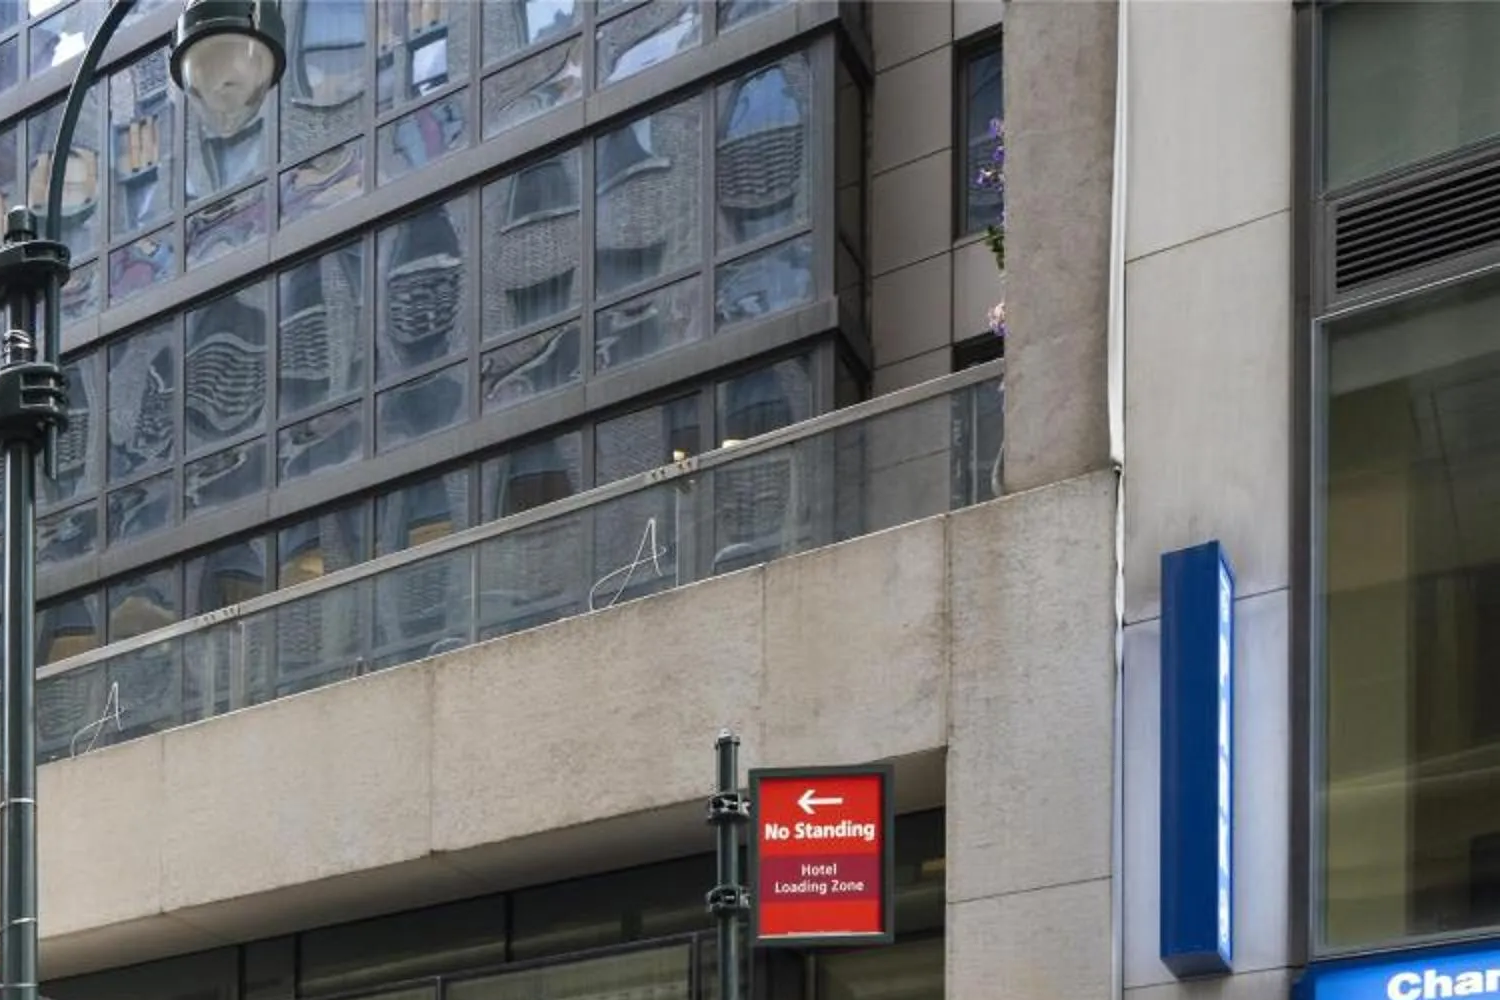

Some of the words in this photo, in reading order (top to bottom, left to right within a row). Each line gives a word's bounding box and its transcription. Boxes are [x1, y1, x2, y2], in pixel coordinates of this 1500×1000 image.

[764, 822, 790, 840] No
[794, 819, 876, 842] Standing
[801, 863, 838, 876] Hotel
[774, 880, 828, 895] Loading
[831, 879, 865, 892] Zone
